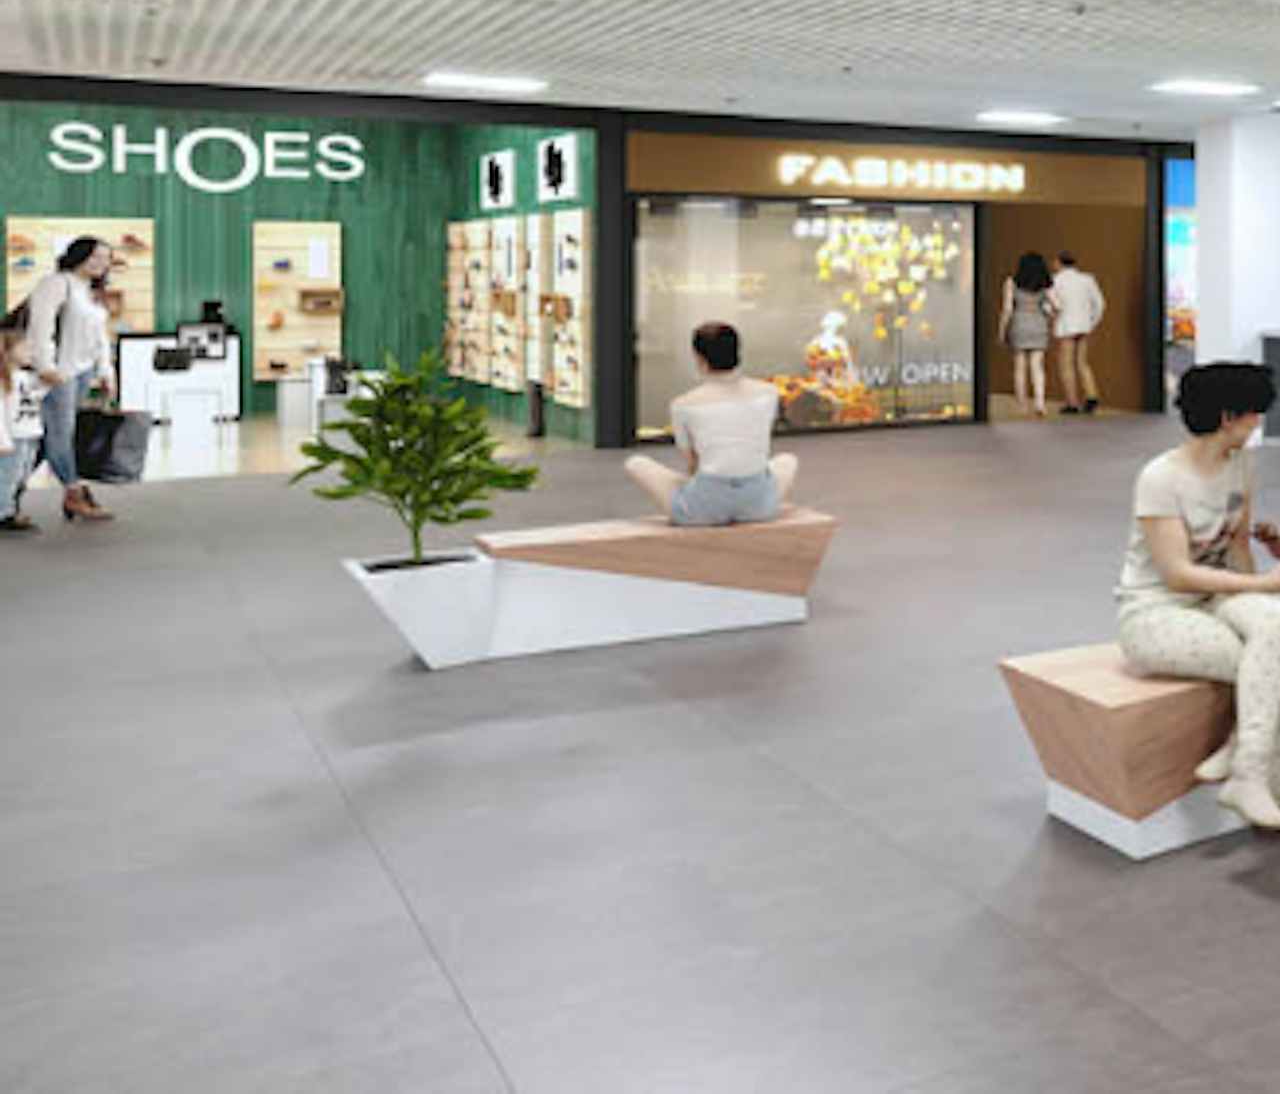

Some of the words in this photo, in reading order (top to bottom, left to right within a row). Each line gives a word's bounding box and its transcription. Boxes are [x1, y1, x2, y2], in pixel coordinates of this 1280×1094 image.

[48, 122, 366, 193] SHOES
[778, 153, 1026, 192] FASHION
[902, 361, 972, 385] OPEN
